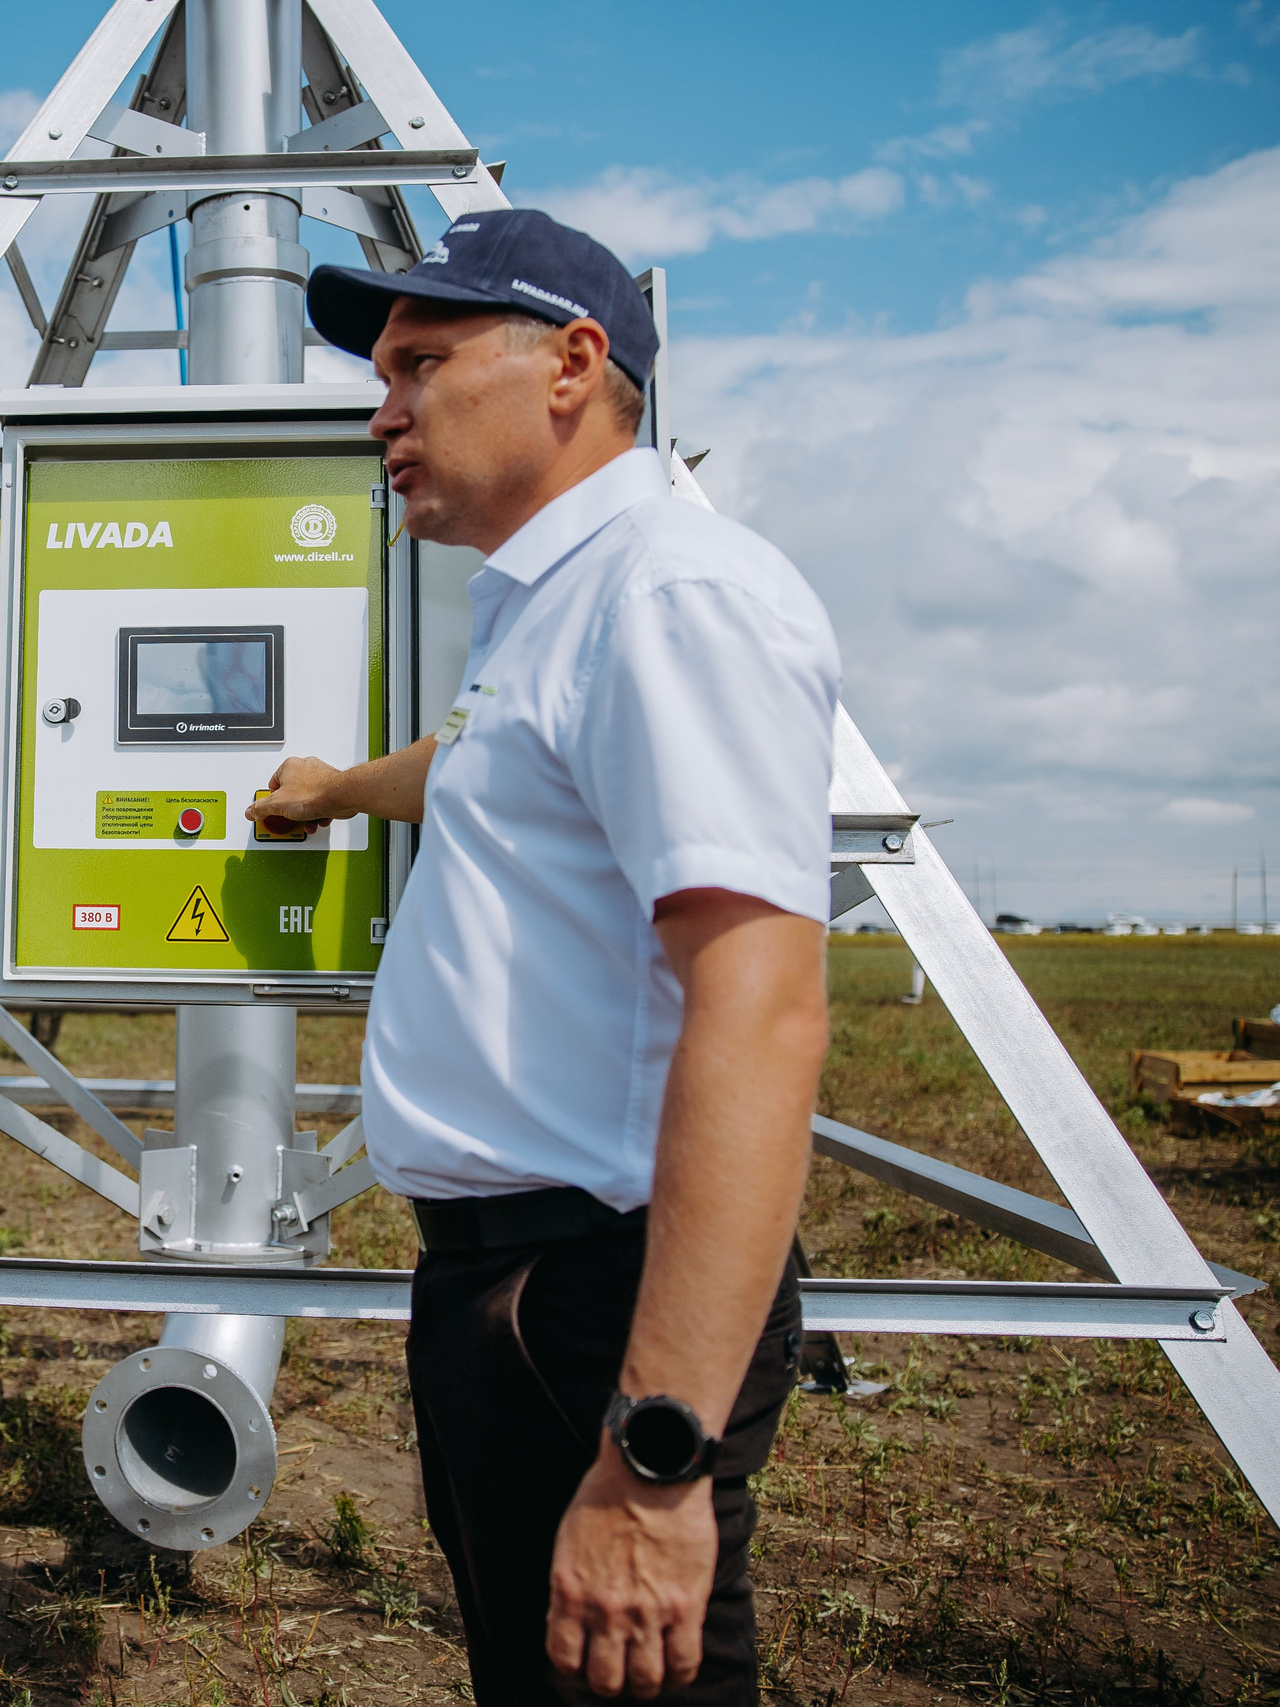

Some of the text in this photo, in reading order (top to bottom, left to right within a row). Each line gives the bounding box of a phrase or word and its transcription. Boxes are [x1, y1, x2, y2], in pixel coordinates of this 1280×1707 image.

[46, 521, 174, 549] LIVADA
[273, 551, 354, 562] www.dizell.ru
[189, 723, 226, 731] irrimatic
[79, 911, 113, 923] 380 В
[279, 906, 313, 933] EAC
